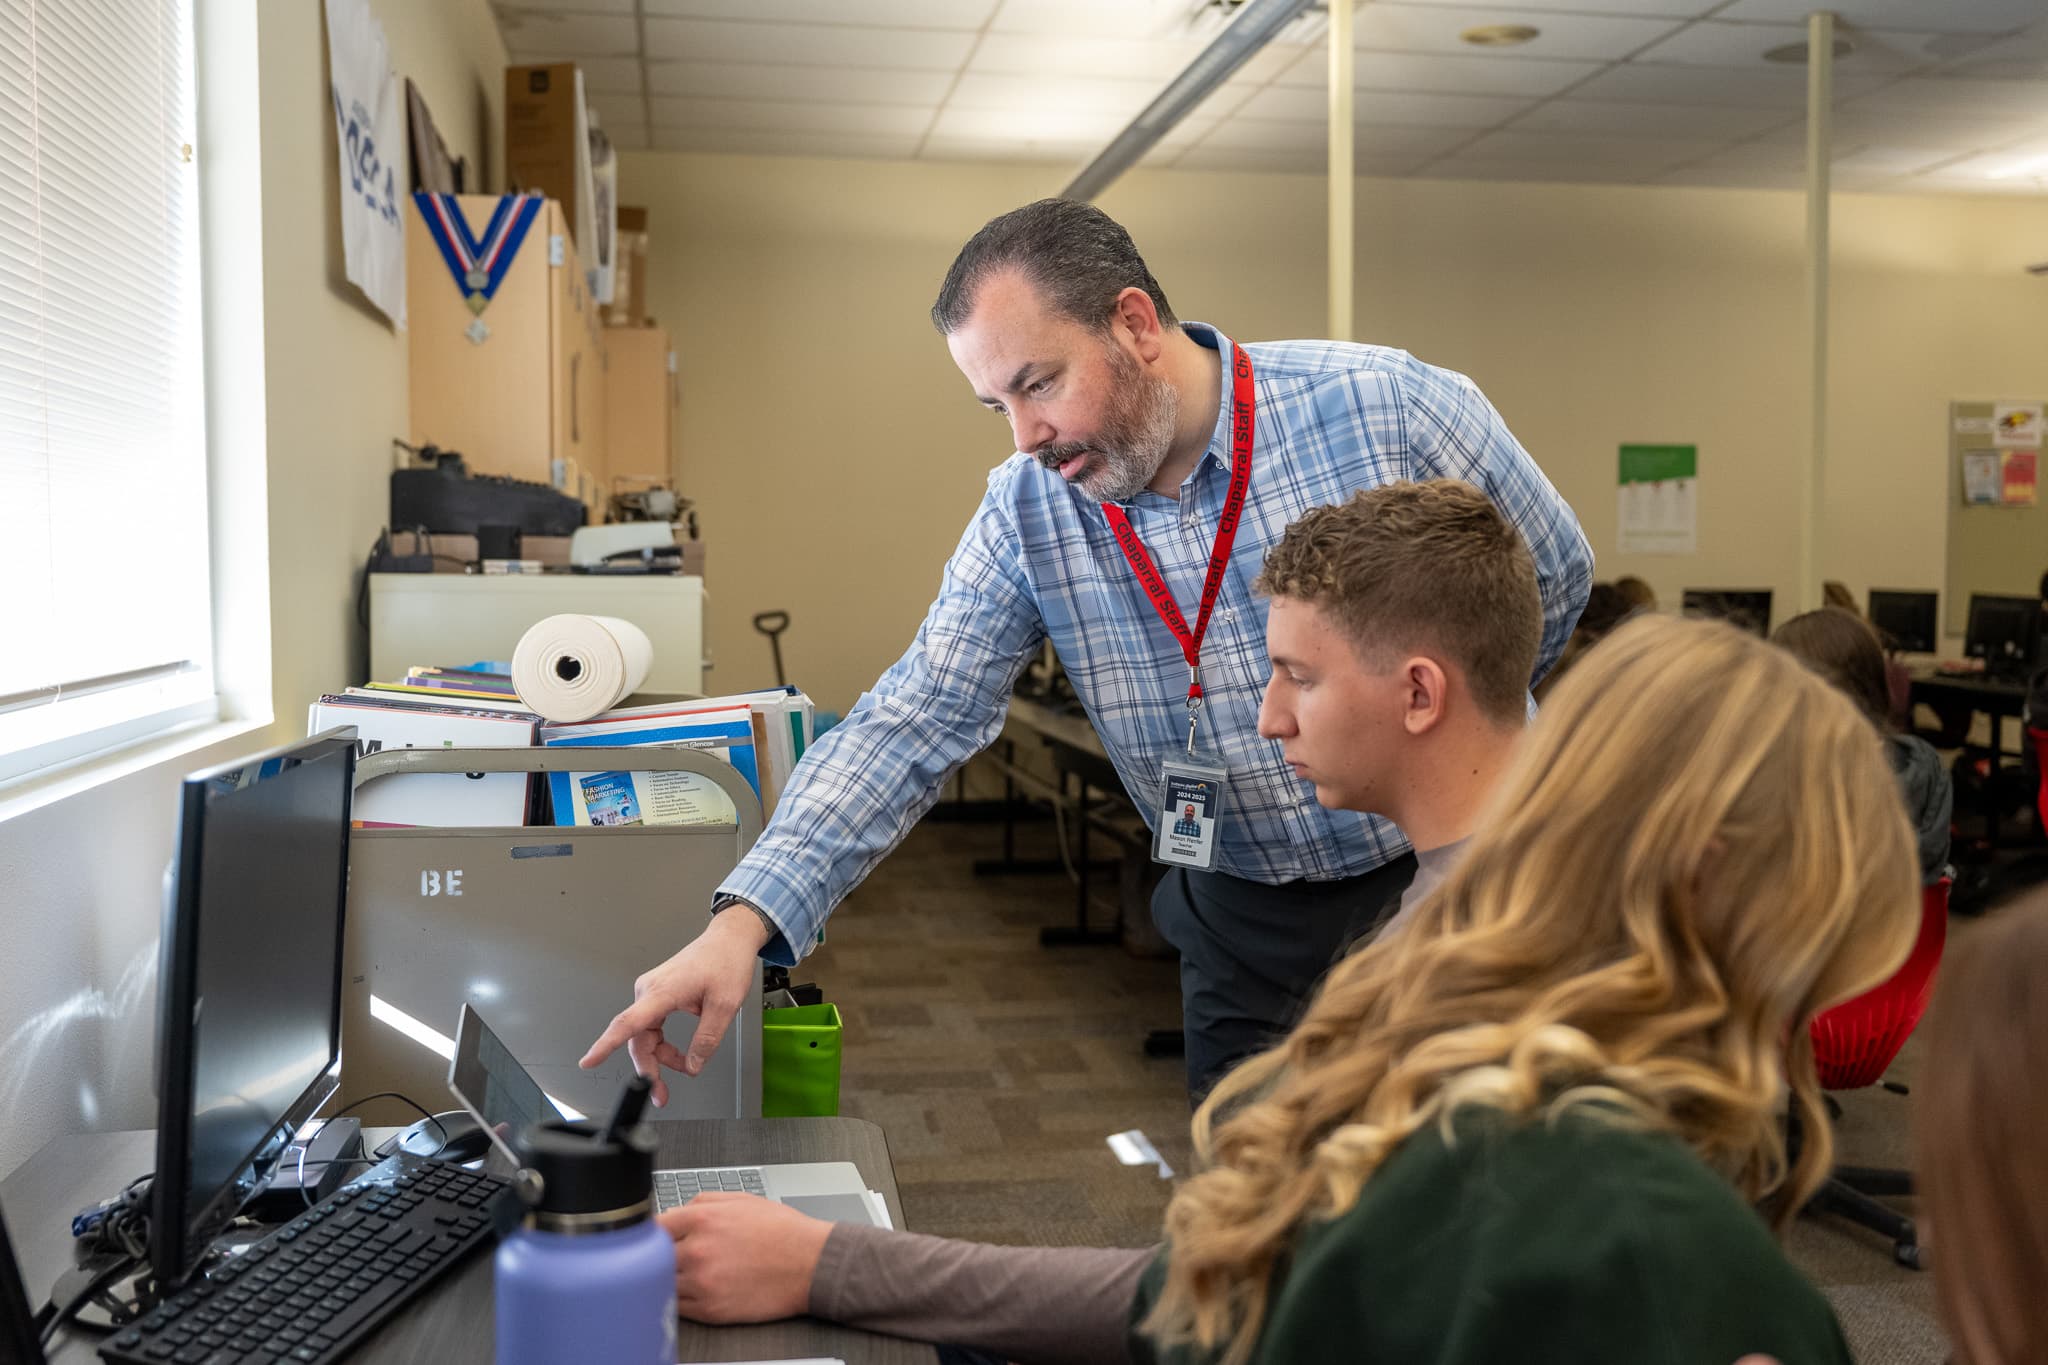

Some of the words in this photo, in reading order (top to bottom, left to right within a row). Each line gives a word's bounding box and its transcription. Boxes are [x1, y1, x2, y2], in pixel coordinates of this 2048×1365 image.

[1221, 449, 1248, 534] Chaparral
[1236, 402, 1249, 443] Staff
[1117, 522, 1167, 598] Chaparral
[1159, 600, 1189, 636] Staff
[1206, 557, 1223, 599] Staff
[586, 783, 614, 795] FASHION
[587, 787, 626, 801] MARKETING
[421, 870, 463, 896] BE
